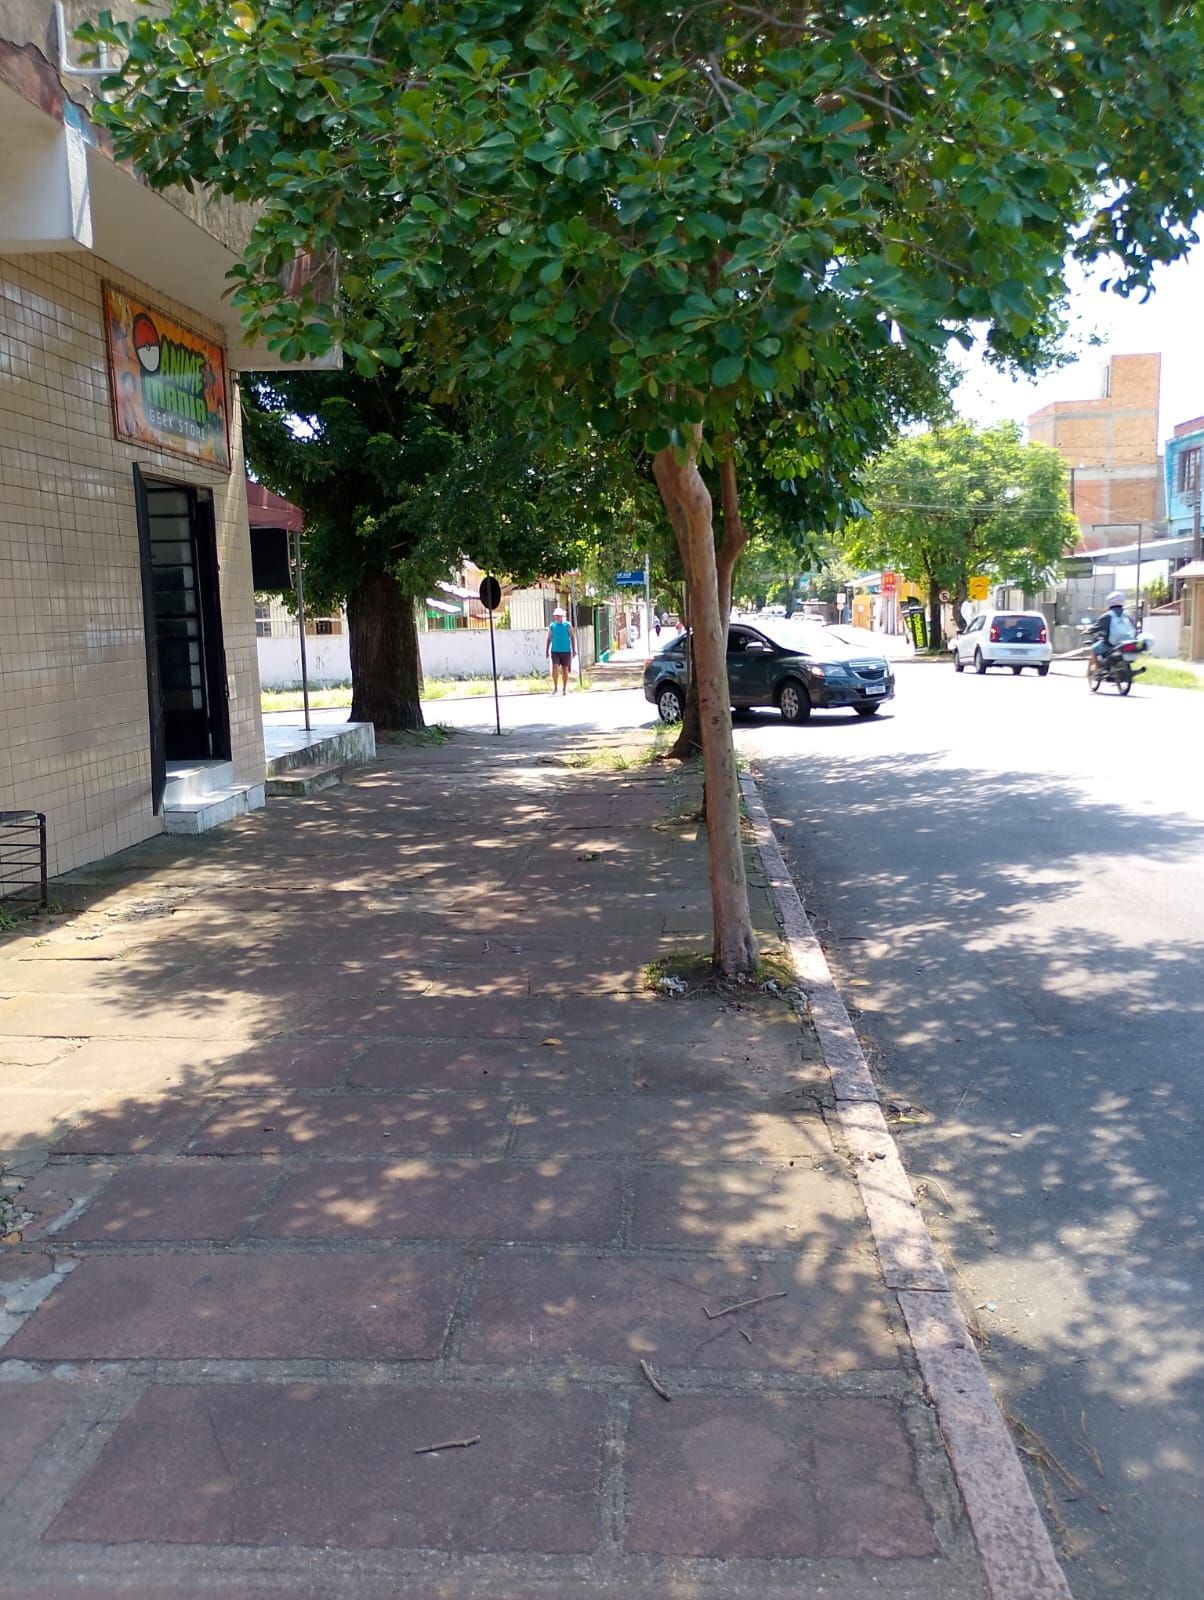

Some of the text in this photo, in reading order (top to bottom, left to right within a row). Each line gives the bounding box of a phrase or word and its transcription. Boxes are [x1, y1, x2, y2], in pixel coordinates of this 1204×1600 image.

[160, 340, 205, 395] ANIME
[143, 375, 207, 425] MANIA
[149, 409, 206, 441] GEEK STORE
